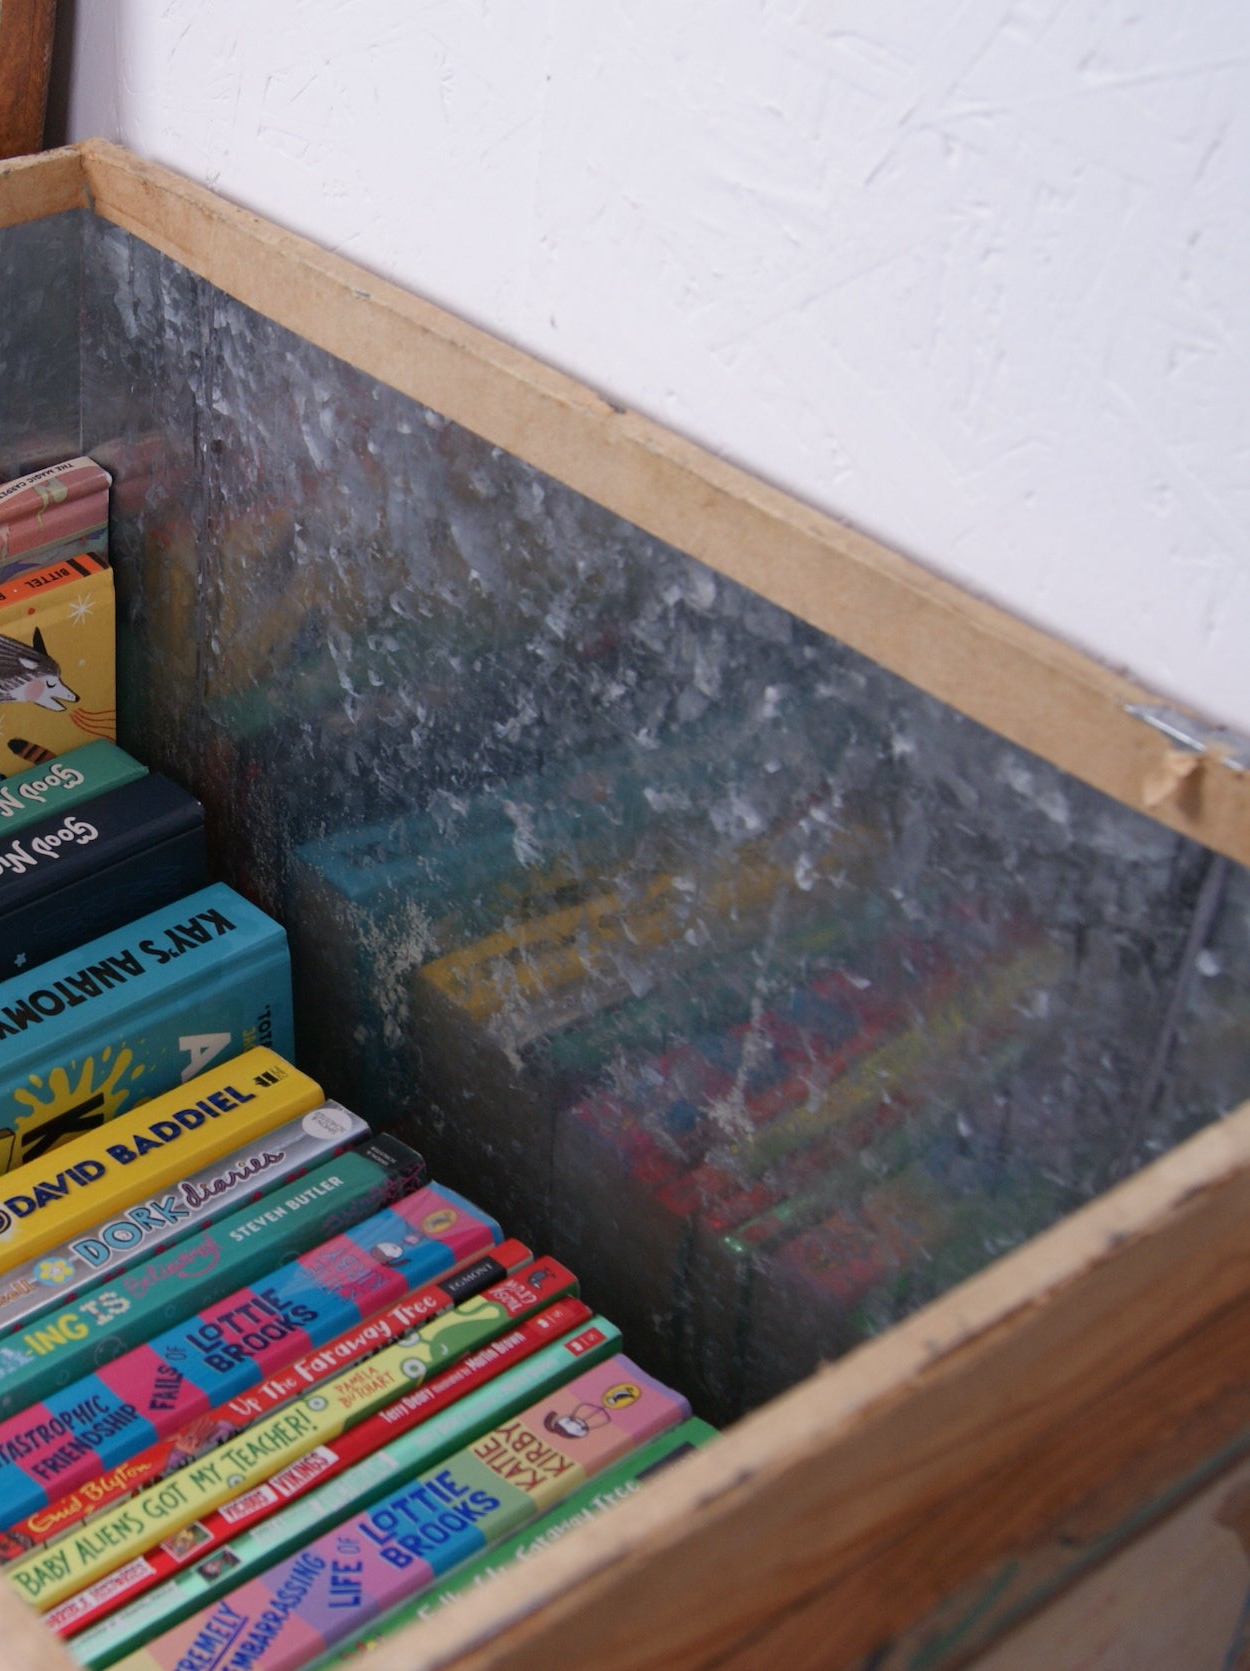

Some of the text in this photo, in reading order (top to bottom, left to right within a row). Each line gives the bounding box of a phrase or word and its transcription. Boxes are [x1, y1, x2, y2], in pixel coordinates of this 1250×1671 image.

[26, 469, 54, 483] MAGIC
[55, 463, 74, 472] THE
[24, 567, 71, 589] BITTEL
[138, 908, 237, 965] KAY'S
[4, 1159, 106, 1219] DAVID
[106, 1085, 256, 1165] BADDIEL
[72, 1196, 190, 1267] DORK
[229, 1206, 287, 1243] STEVEN
[285, 1176, 344, 1211] BUTLER
[80, 1291, 131, 1327] IS
[448, 1263, 493, 1292] EGMONT
[186, 1287, 293, 1354] LOTTIE
[203, 1304, 319, 1374] BROOKS
[149, 1345, 187, 1411] FAILS OF
[229, 1390, 263, 1417] Up
[294, 1318, 392, 1382] Faraway
[387, 1295, 438, 1329] Tree
[333, 1366, 379, 1395] PAMELA
[378, 1403, 410, 1424] Terry
[402, 1388, 435, 1410] Deary
[465, 1348, 499, 1372] Martin
[491, 1331, 526, 1354] Brown
[338, 1371, 396, 1409] BUTCHART
[31, 1404, 138, 1481] FRIENDSHIP
[271, 1450, 328, 1491] VIKINGS
[473, 1435, 548, 1493] KATIE
[494, 1419, 576, 1478] KIRBY
[12, 1549, 71, 1597] BABY
[75, 1513, 145, 1566] ALIENS
[141, 1481, 189, 1520] GOT
[190, 1463, 225, 1493] MY
[27, 1463, 152, 1533] Enid Blyton
[357, 1469, 471, 1546] LOTTIE
[379, 1490, 501, 1569] BROOKS
[328, 1536, 363, 1609] LIFE OF
